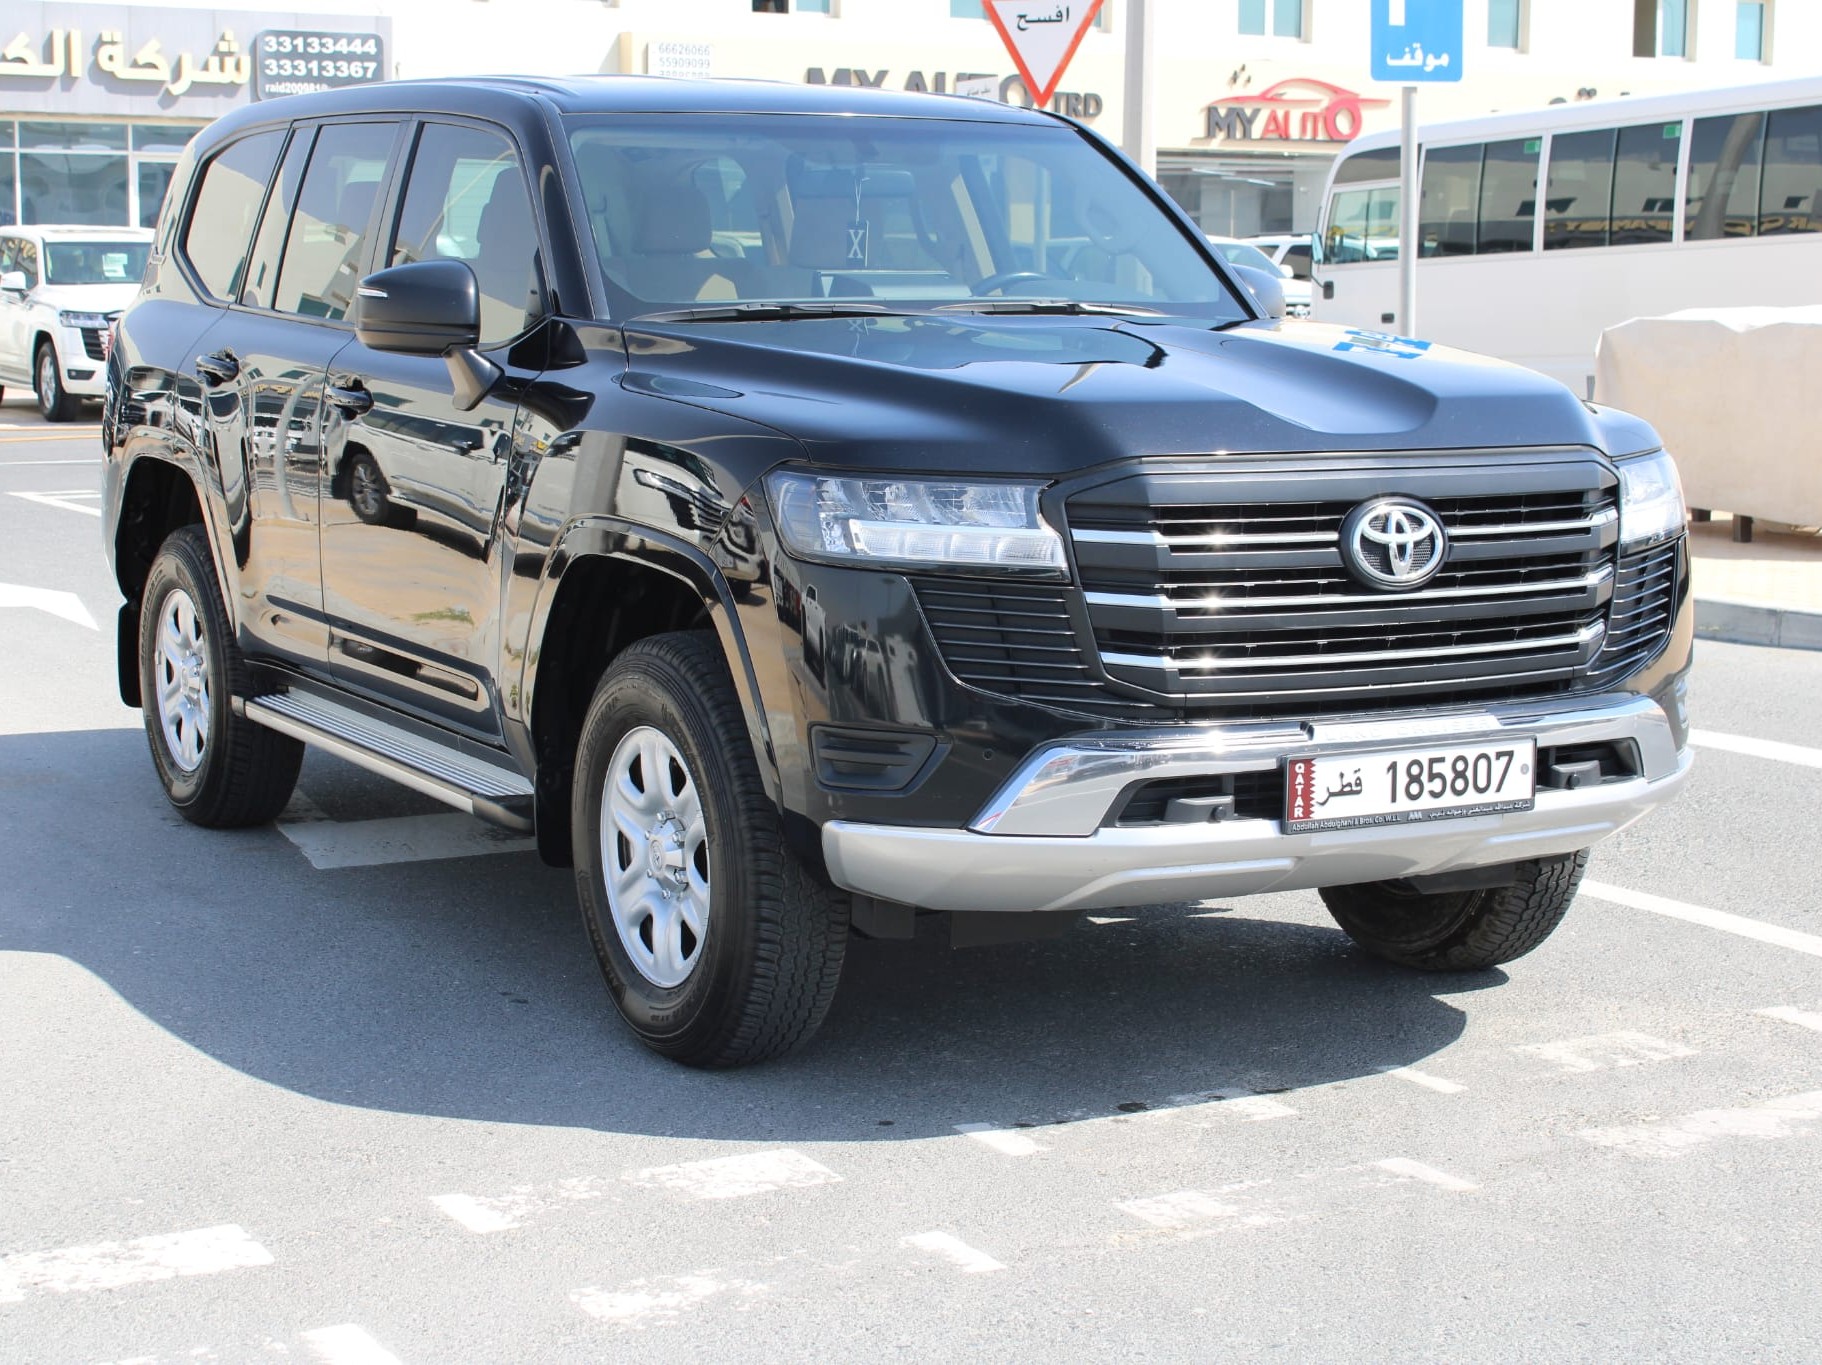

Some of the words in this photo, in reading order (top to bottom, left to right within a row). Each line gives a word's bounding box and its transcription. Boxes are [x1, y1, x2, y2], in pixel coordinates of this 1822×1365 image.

[1016, 4, 1070, 31] افسح
[264, 36, 378, 55] 33133444
[1386, 42, 1450, 72] موقف
[97, 29, 251, 96] شركة
[264, 59, 378, 79] 33313367
[847, 229, 865, 258] X
[1293, 762, 1305, 818] QATAR
[1316, 769, 1363, 805] قطر
[1386, 750, 1515, 804] 185807
